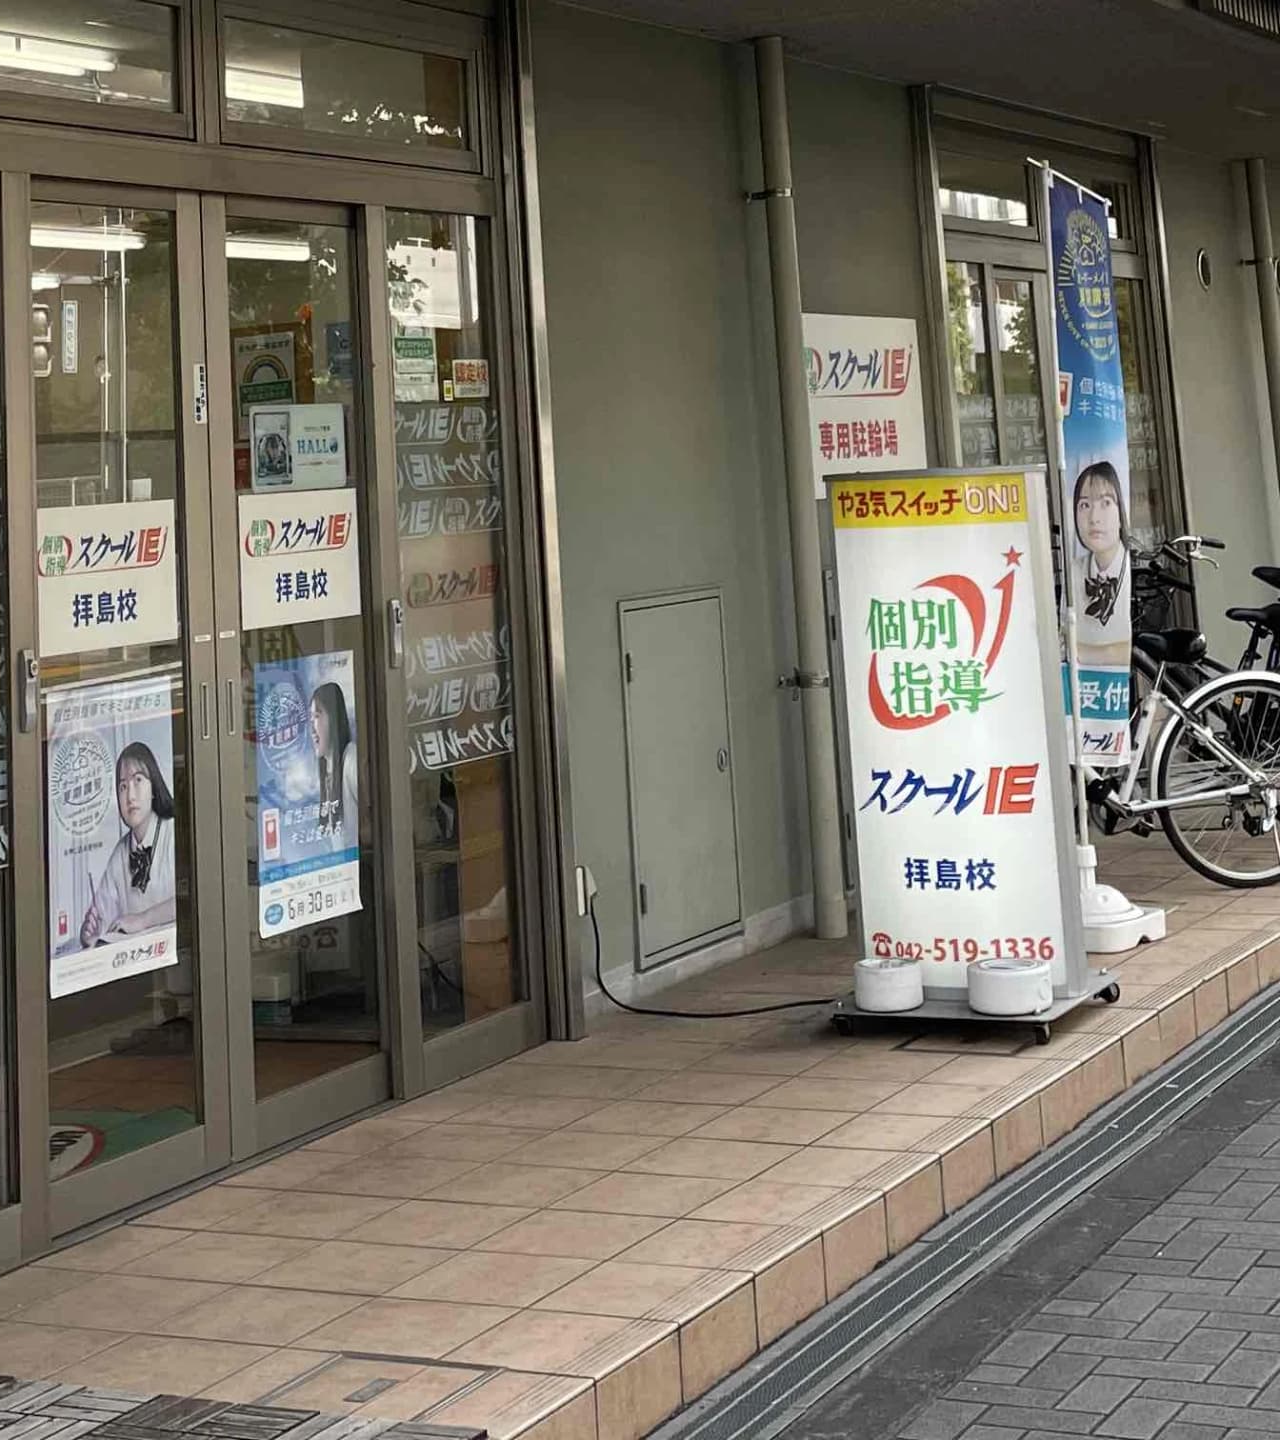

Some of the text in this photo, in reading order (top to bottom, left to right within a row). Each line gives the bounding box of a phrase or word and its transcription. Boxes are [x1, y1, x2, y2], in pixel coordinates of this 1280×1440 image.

[822, 348, 906, 391] スクールIE
[818, 419, 899, 460] 専用駐輪場
[71, 527, 163, 569] スクールIE
[274, 512, 348, 551] スクールIE
[276, 567, 329, 604] 拝島校
[72, 588, 138, 628] 拝島校
[866, 598, 959, 651] 個別
[888, 659, 1003, 717] 指導
[858, 763, 1040, 816] スクールIE
[904, 857, 997, 891] 拝島校
[895, 936, 1055, 963] 042-519-1336
